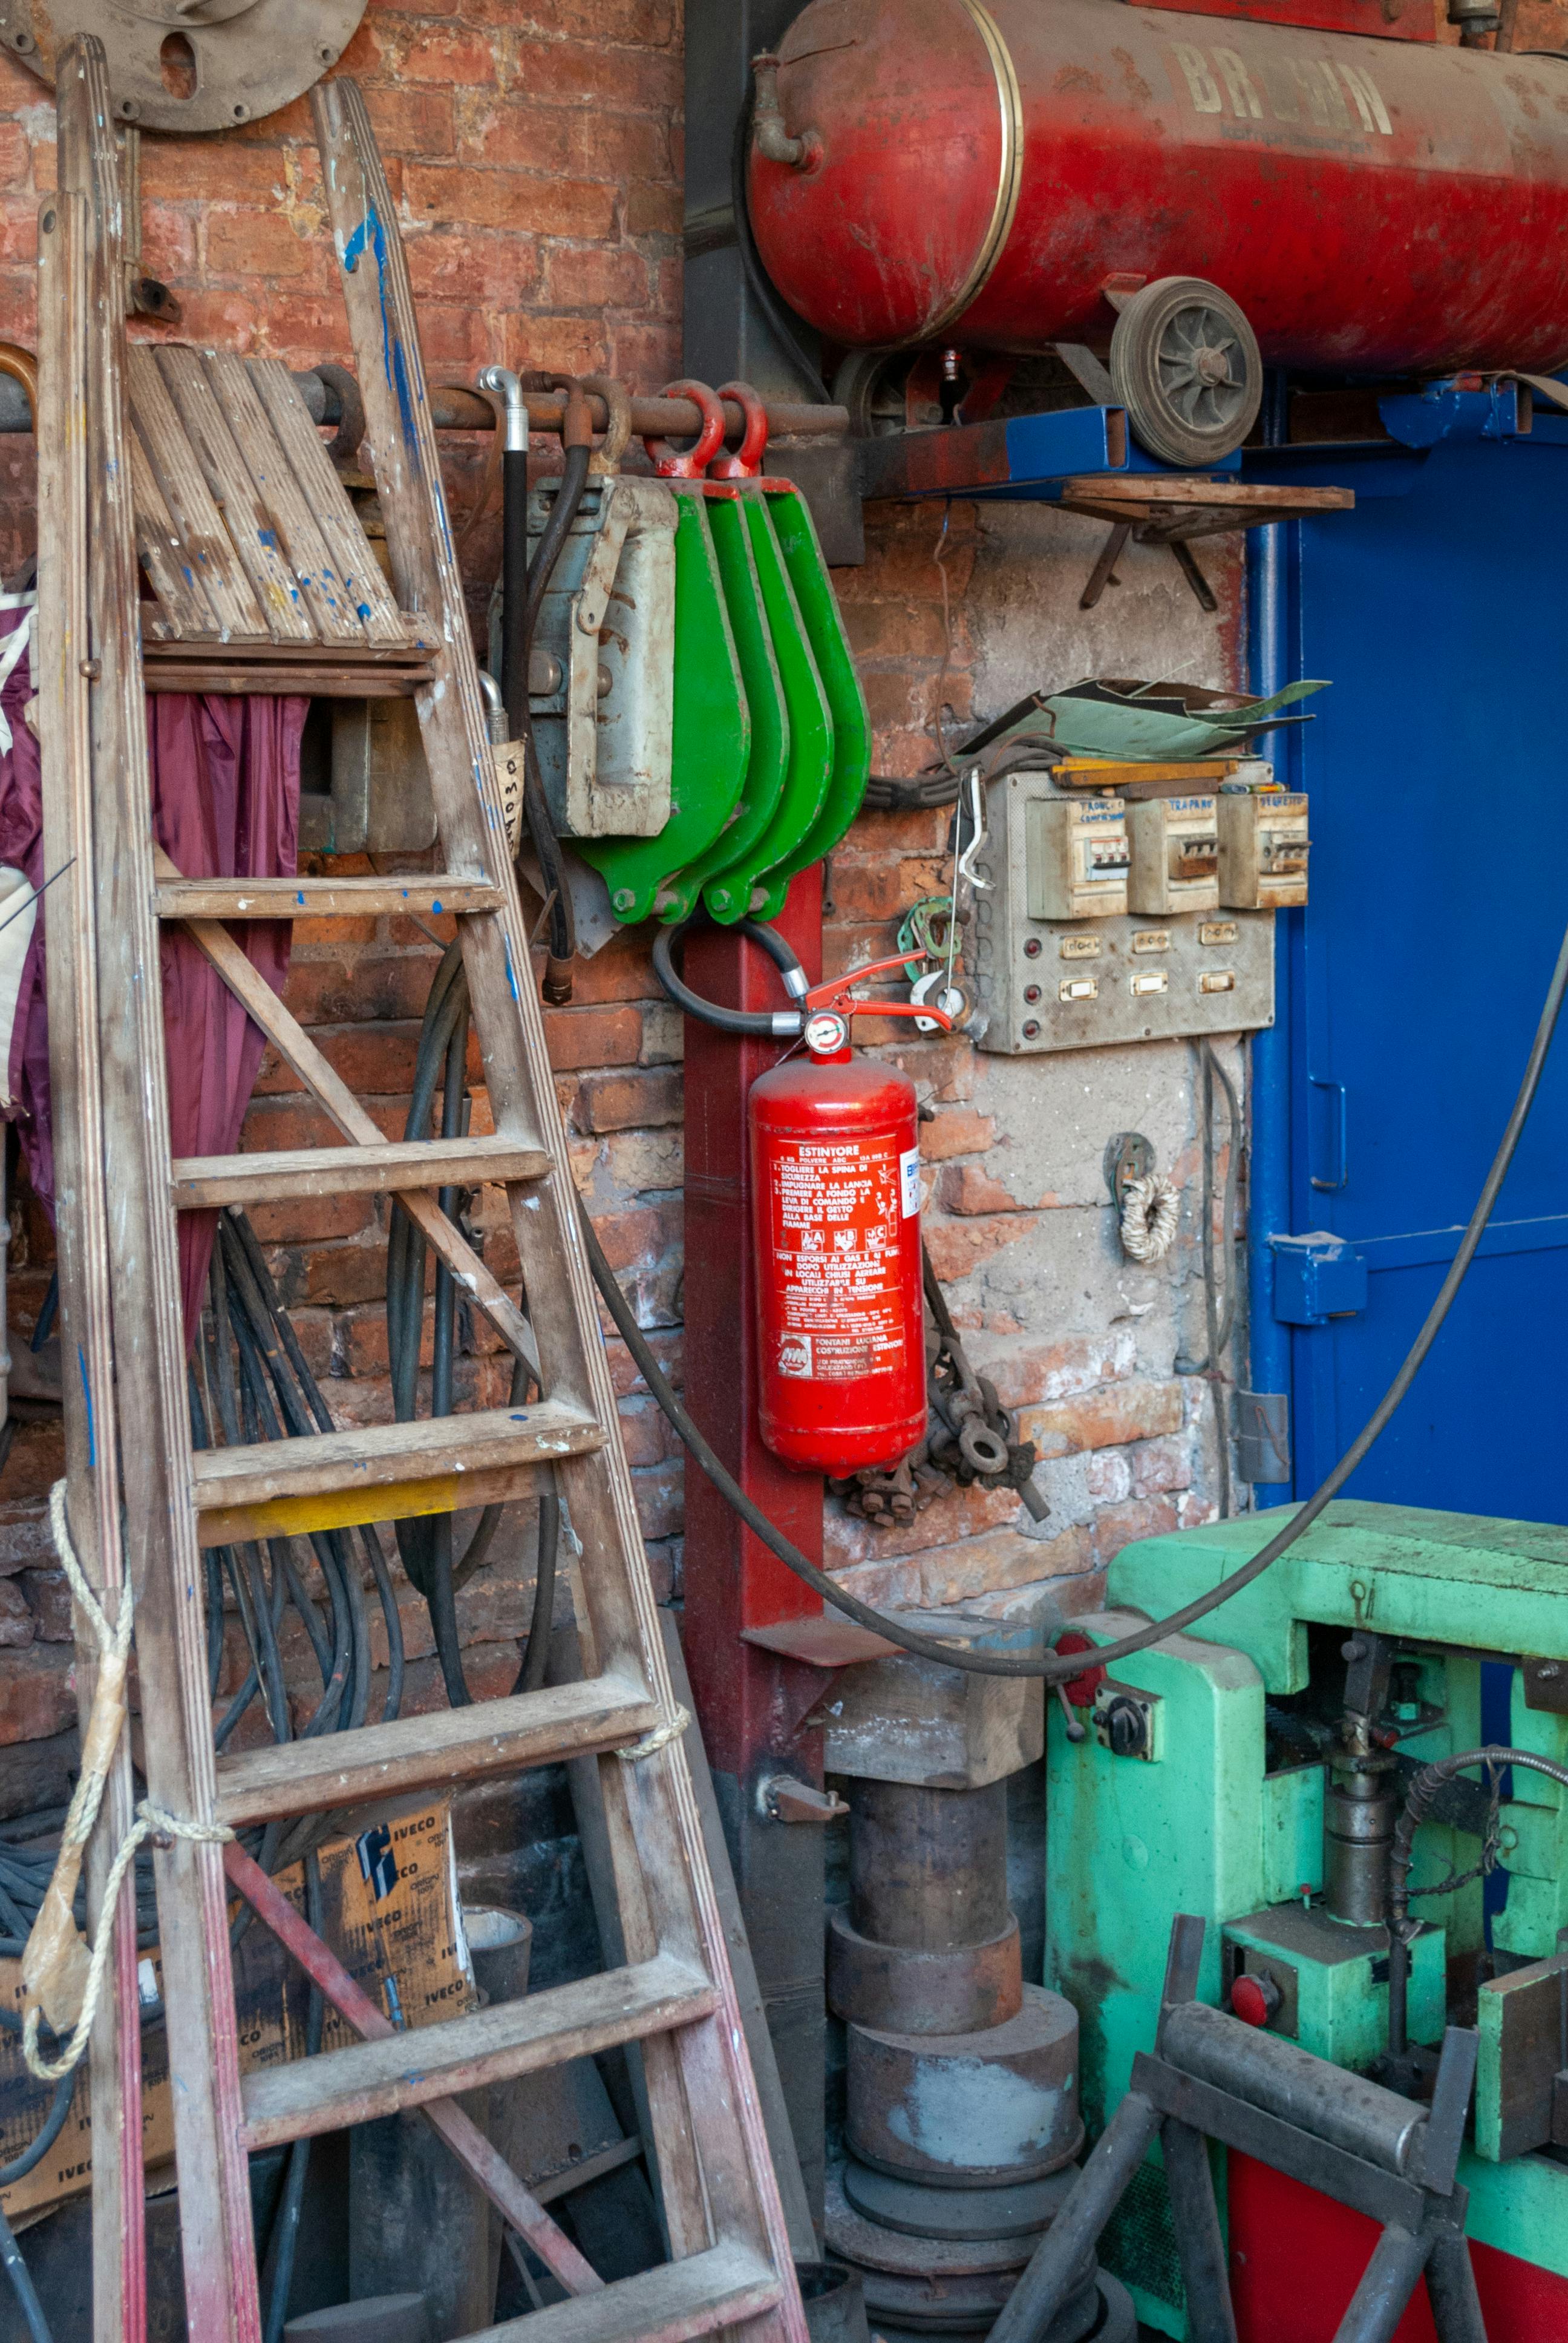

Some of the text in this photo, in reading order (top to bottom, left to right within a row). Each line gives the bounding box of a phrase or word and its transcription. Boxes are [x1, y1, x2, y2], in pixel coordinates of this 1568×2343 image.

[799, 1145, 859, 1156] ESTINTORE
[781, 1164, 814, 1174] TOGLIERE
[832, 1165, 856, 1174] SPINA
[781, 1173, 821, 1182] SICUREZZA
[782, 1181, 825, 1190] IMPUGNARE
[844, 1179, 872, 1189] LANCIA
[782, 1188, 812, 1198] PREMERE
[826, 1189, 857, 1198] FONDO
[782, 1196, 799, 1205] LEVA
[812, 1197, 857, 1206] COMANDO
[782, 1204, 813, 1214] DIRIGERE
[826, 1205, 854, 1214] GETTO
[782, 1212, 800, 1221] ALLA
[803, 1213, 823, 1222] BASE
[782, 1219, 811, 1229] FIAMME
[814, 1232, 822, 1241] A
[848, 1231, 854, 1240] B
[877, 1227, 884, 1237] C
[777, 1253, 792, 1262] NON
[823, 1260, 880, 1271] UTILIZZAZIONE
[855, 1267, 886, 1277] AEREARE
[786, 1285, 829, 1294] APPARECCHI
[848, 1283, 883, 1293] TENSIONE
[394, 1817, 435, 1842] IVECO
[361, 1910, 402, 1936] IVECO
[426, 1979, 463, 2006] IVECO
[58, 2160, 93, 2183] IVEC
